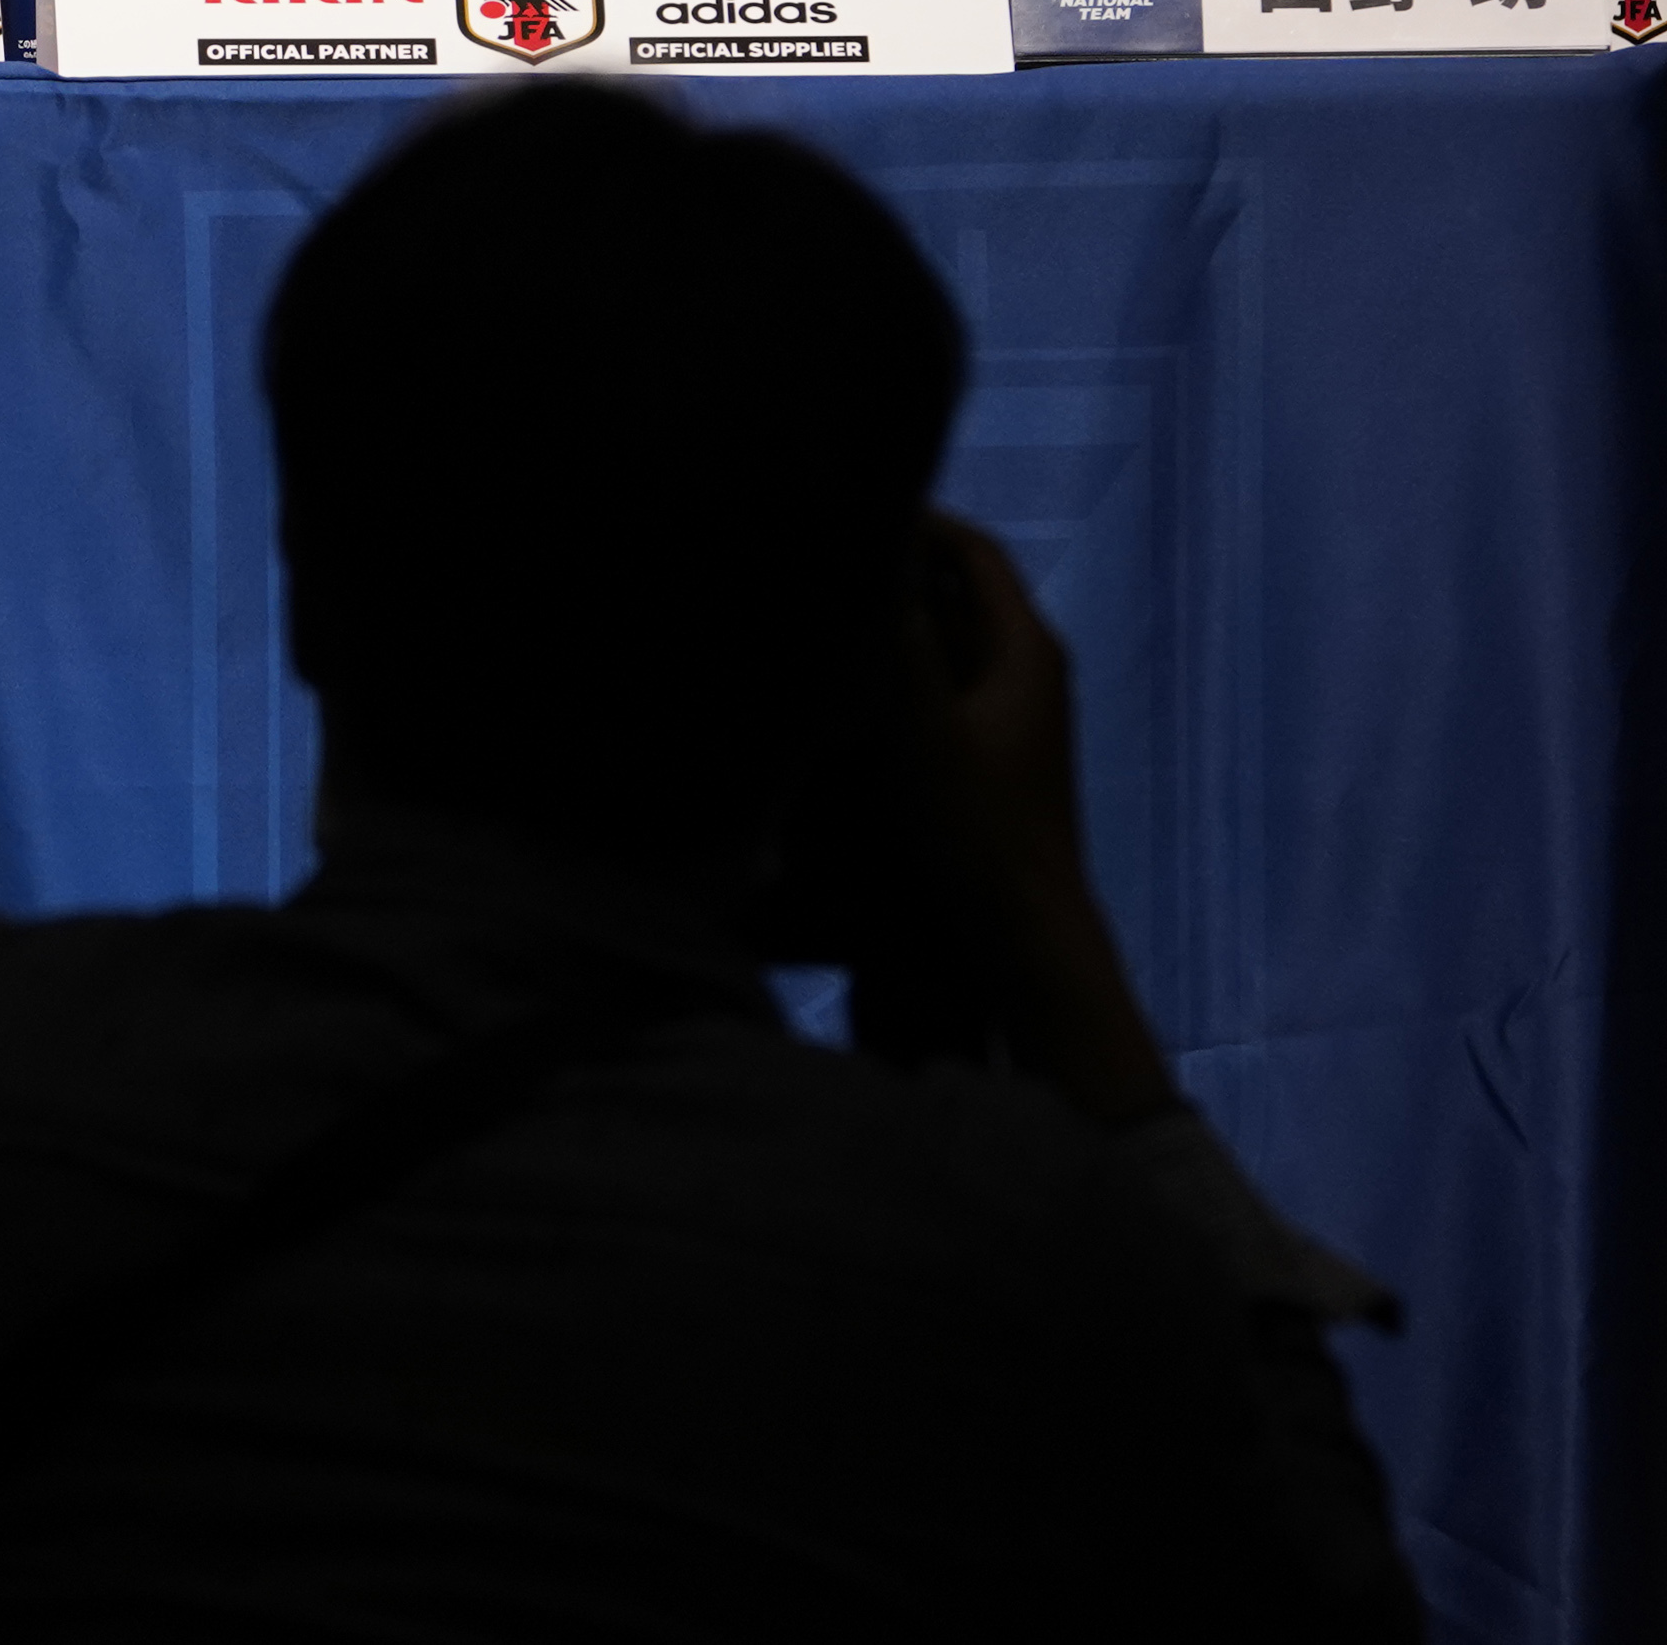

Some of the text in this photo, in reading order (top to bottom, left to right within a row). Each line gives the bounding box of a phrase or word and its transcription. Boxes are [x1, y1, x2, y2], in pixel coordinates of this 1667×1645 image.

[1079, 7, 1131, 21] TEAM
[498, 21, 567, 41] JFA
[206, 44, 429, 60] OFFICIAL PARTNER
[637, 40, 862, 58] OFFICIAL SUPPLIER
